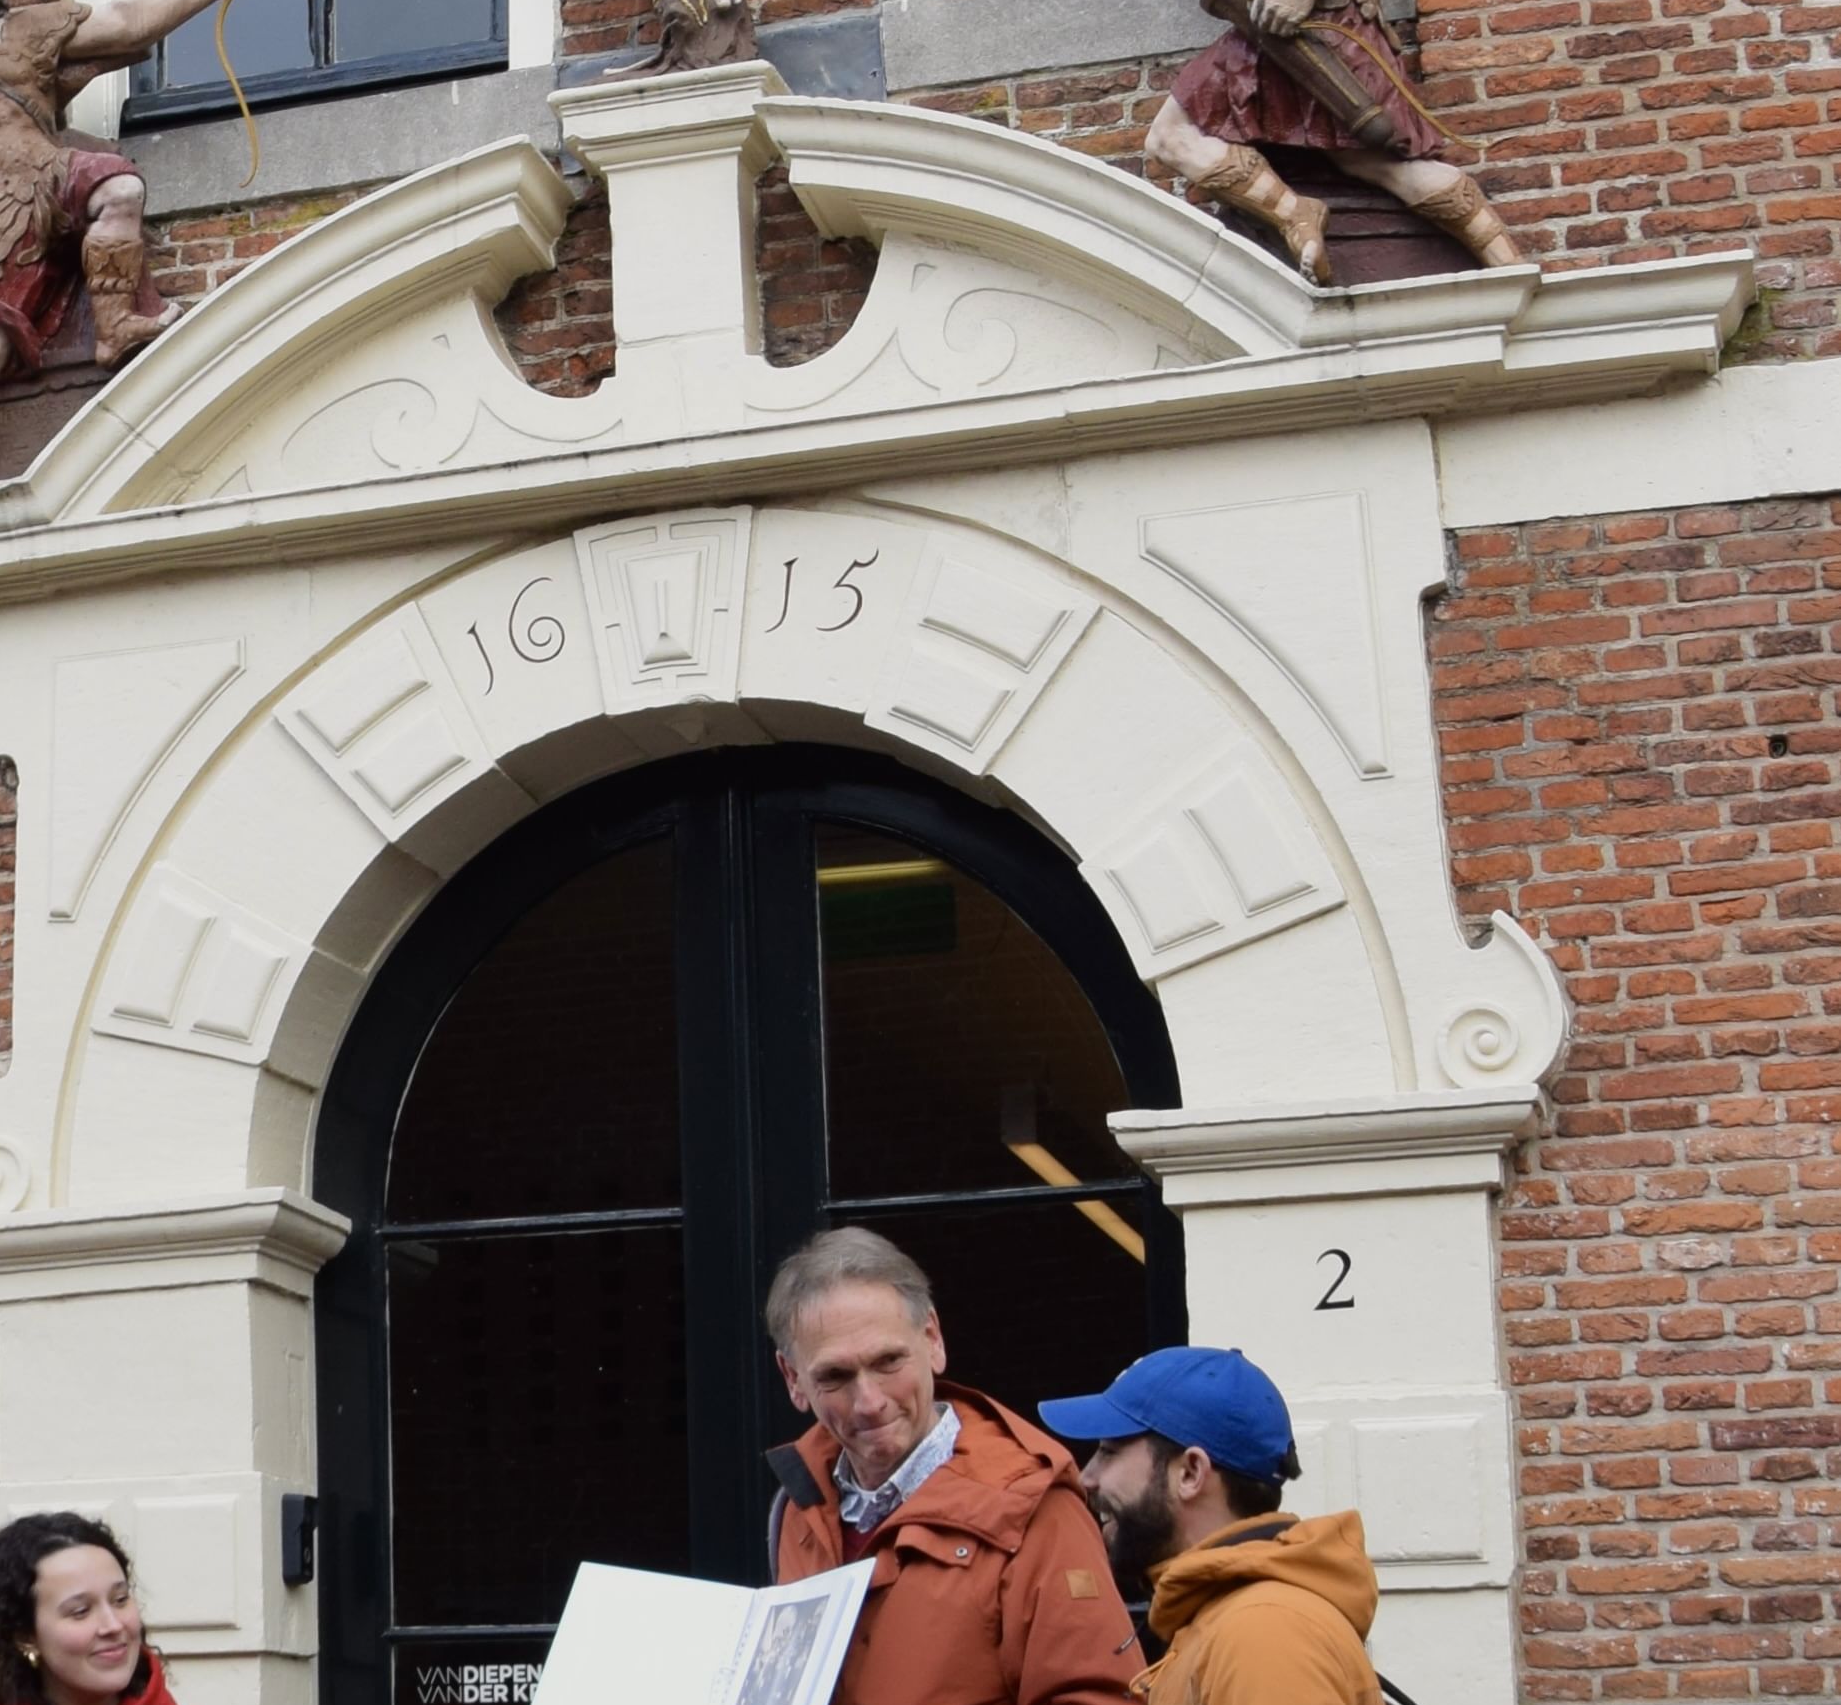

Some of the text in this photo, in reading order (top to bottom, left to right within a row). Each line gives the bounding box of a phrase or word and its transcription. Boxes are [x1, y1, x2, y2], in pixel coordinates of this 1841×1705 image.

[467, 548, 880, 696] 16 15
[1313, 1248, 1355, 1311] 2
